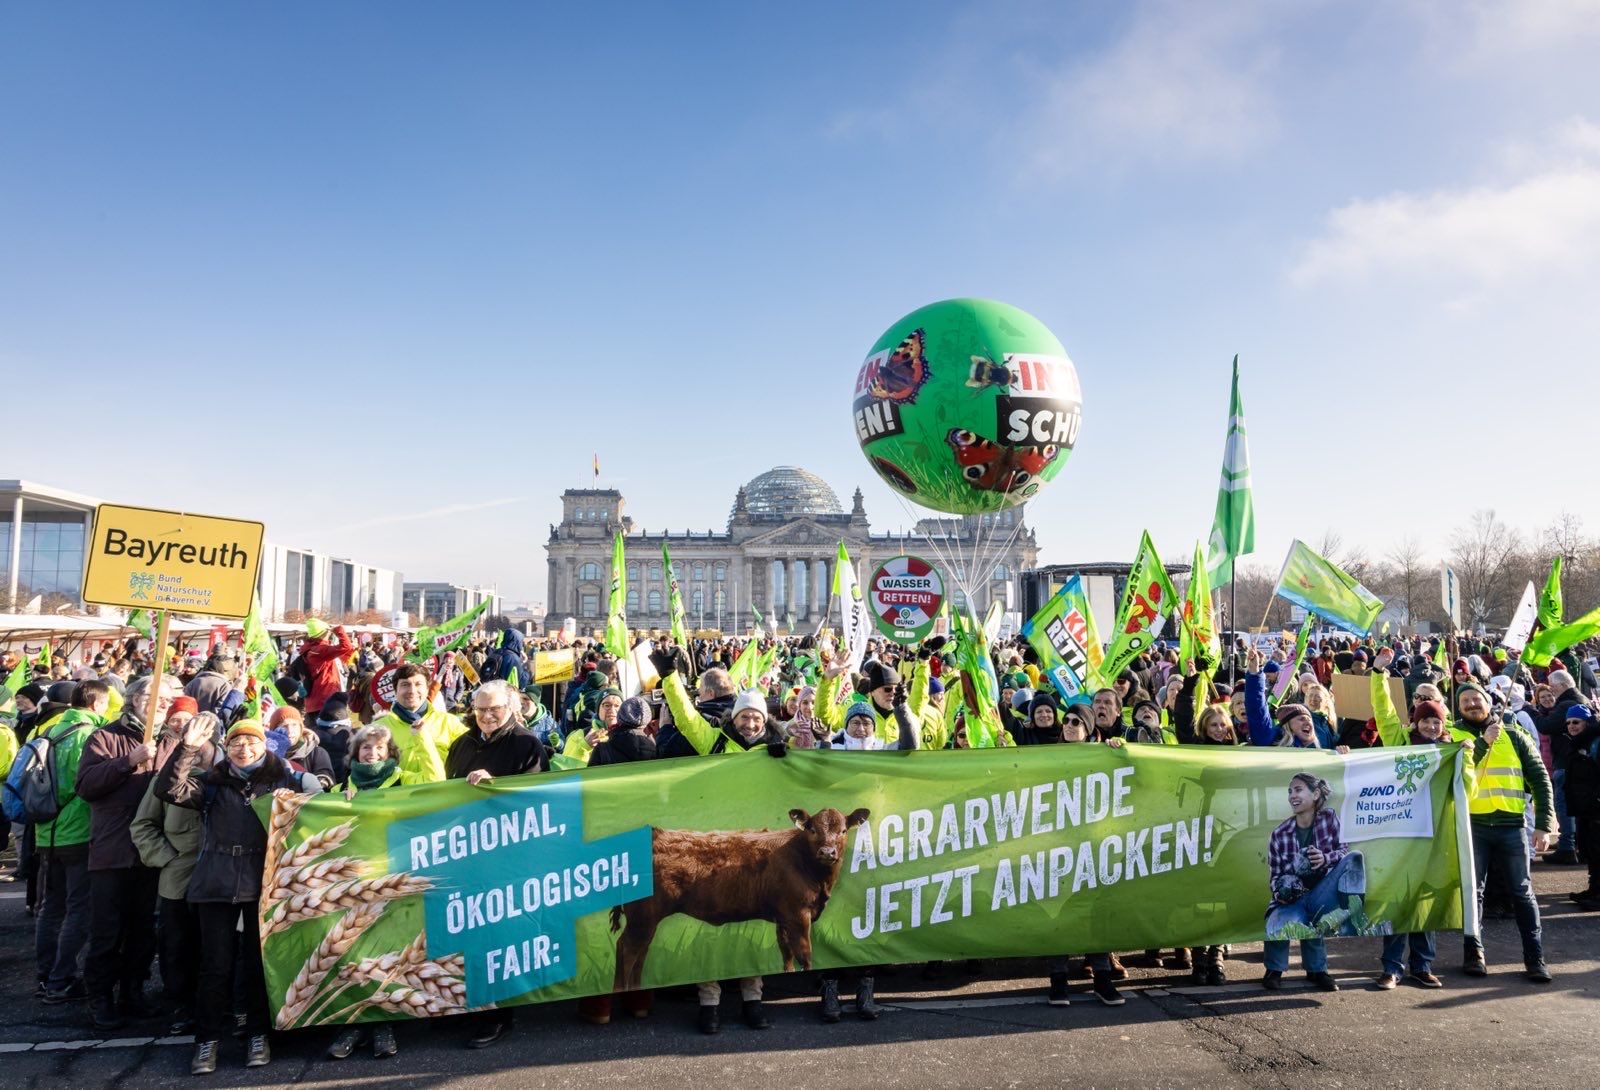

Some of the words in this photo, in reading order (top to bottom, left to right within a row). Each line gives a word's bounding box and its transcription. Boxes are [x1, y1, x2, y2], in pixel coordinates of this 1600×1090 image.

[103, 528, 248, 569] Bayreuth
[158, 574, 182, 583] Bund
[882, 579, 931, 588] WASSER
[156, 584, 212, 596] Naturschutz
[165, 595, 195, 604] Bayern
[883, 592, 931, 604] RETTEN!
[1359, 784, 1395, 798] BUND
[1356, 798, 1413, 811] Naturschutz
[850, 766, 1135, 873] AGRARWENDE
[1355, 814, 1365, 825] in
[1367, 812, 1397, 825] Bayern
[1397, 808, 1413, 819] e.V.
[410, 803, 566, 871] REGIONAL,
[851, 865, 980, 940] JETZT
[991, 815, 1214, 912] ANPACKEN!
[446, 852, 639, 934] ÖKOLOGISCH,
[486, 934, 560, 984] FAIR:
